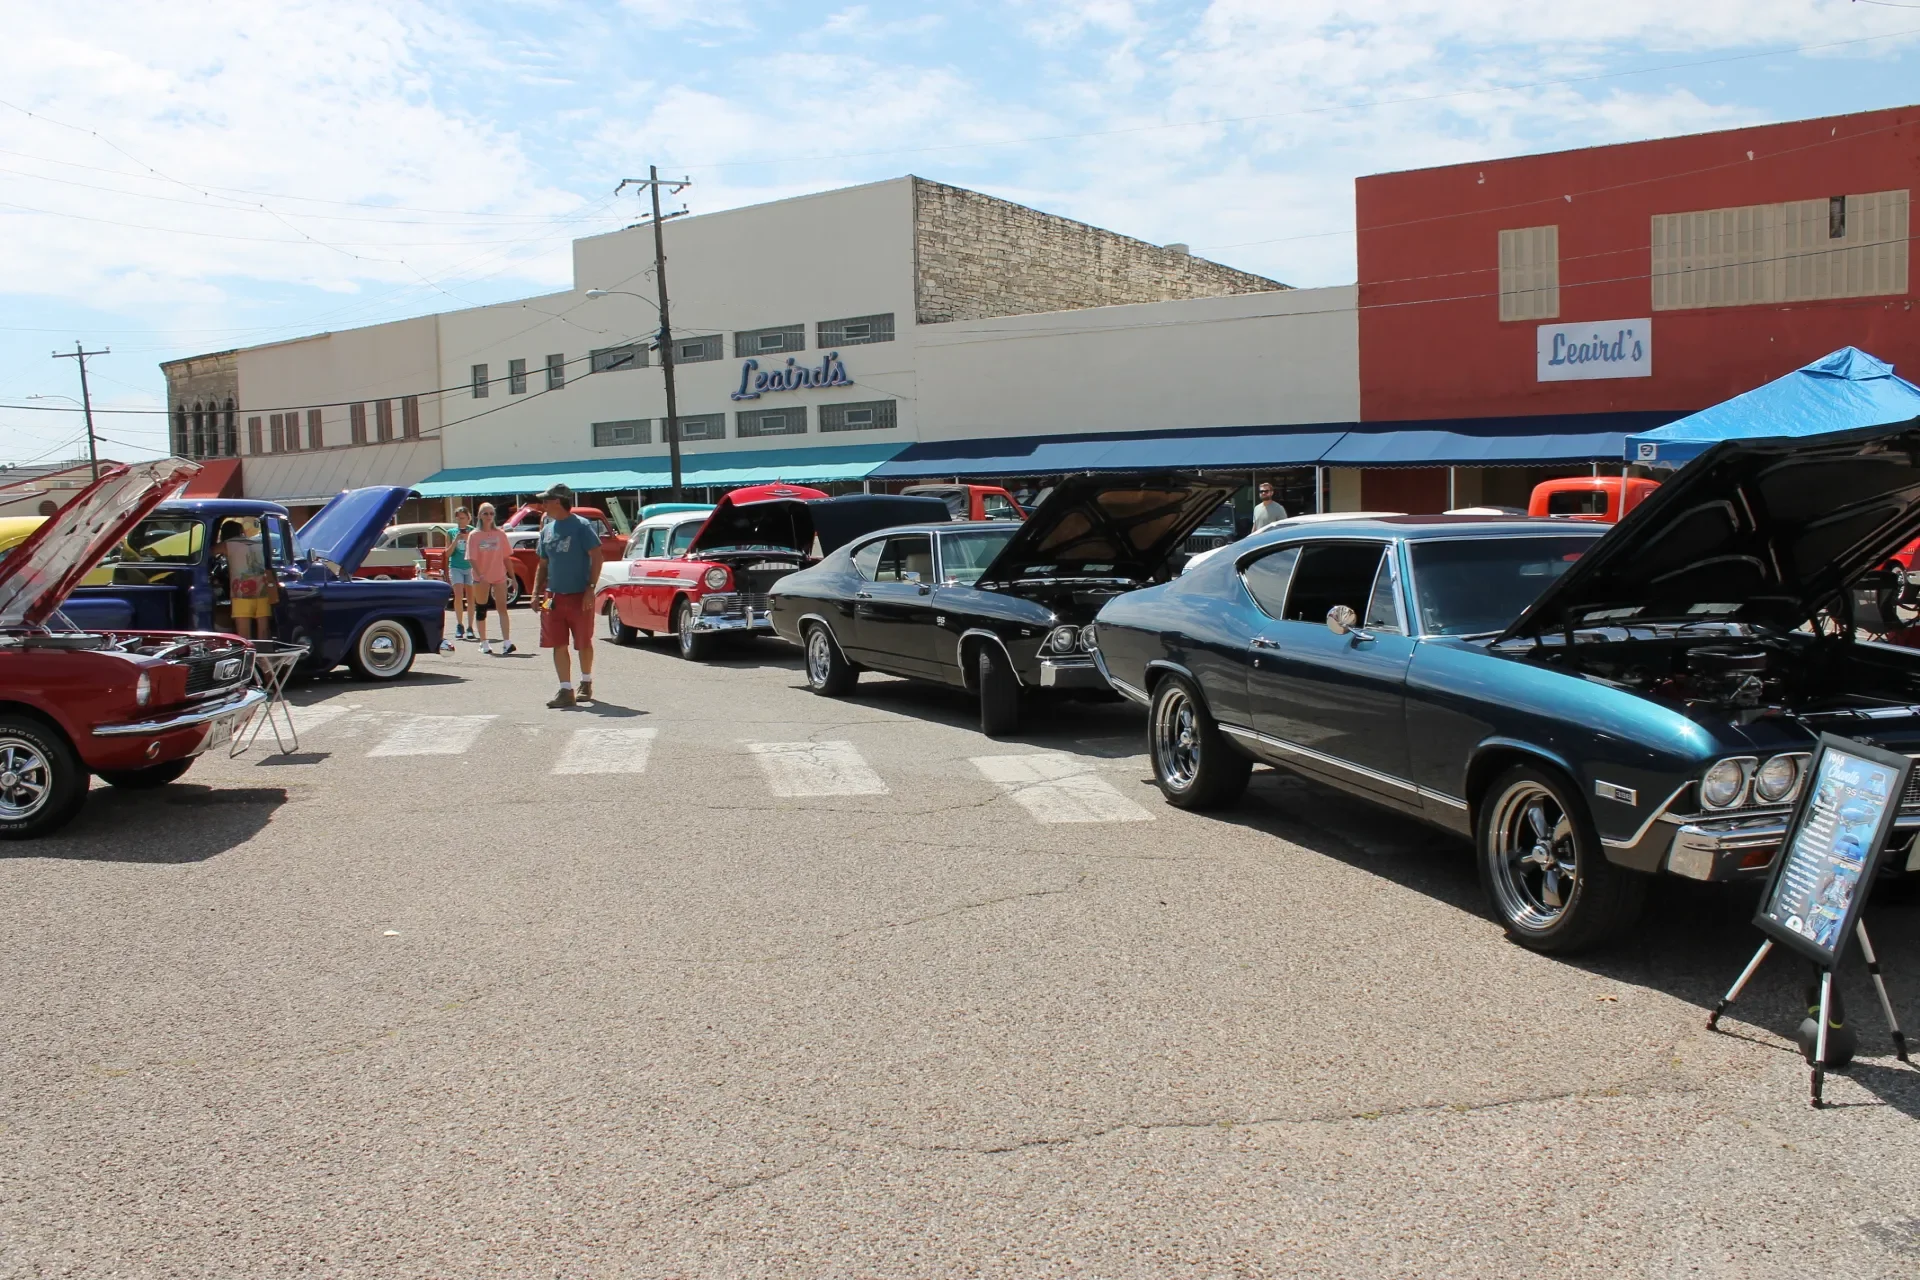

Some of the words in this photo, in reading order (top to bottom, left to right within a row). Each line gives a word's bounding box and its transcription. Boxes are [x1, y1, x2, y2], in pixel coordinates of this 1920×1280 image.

[1548, 329, 1643, 366] Leaird's
[731, 351, 854, 401] Leaird's
[1828, 751, 1845, 767] 1968
[1845, 786, 1857, 797] SS
